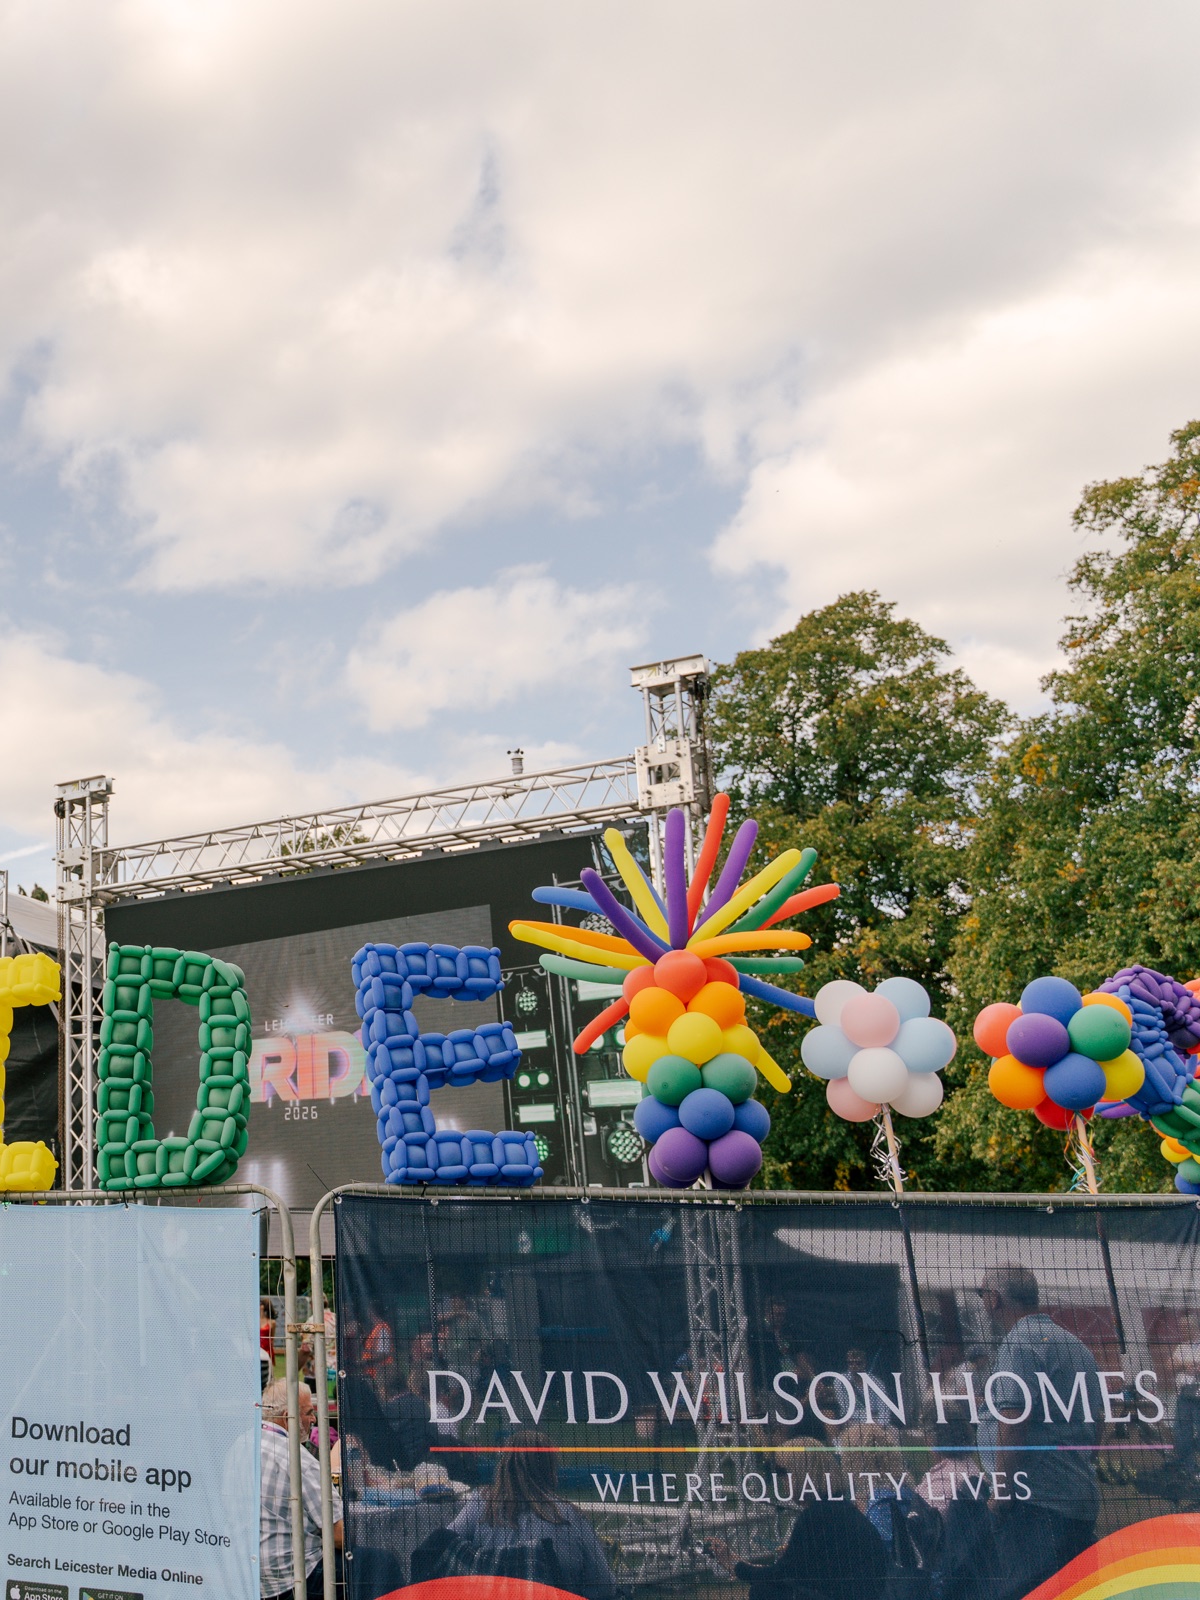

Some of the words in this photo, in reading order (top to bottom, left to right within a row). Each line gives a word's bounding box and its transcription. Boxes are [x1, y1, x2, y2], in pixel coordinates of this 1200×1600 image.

[265, 1013, 334, 1031] LEITER
[284, 1106, 318, 1120] 2026
[428, 1370, 629, 1424] DAVID
[647, 1370, 908, 1427] WILSON
[933, 1369, 1166, 1424] HOMES
[11, 1416, 131, 1446] Download
[9, 1457, 49, 1476] our
[56, 1458, 137, 1484] mobile
[145, 1466, 192, 1493] app
[590, 1472, 728, 1503] WHERE
[741, 1471, 909, 1505] QUALITY
[925, 1471, 1032, 1501] LIVES
[8, 1491, 72, 1510] Available
[75, 1495, 95, 1511] for
[99, 1498, 126, 1514] free
[130, 1500, 143, 1516] in
[147, 1503, 171, 1519] the
[8, 1512, 37, 1531] App
[41, 1515, 79, 1532] Store
[83, 1520, 98, 1534] or
[102, 1520, 154, 1541] Google
[159, 1525, 190, 1546] Play
[194, 1528, 231, 1548] Store
[7, 1553, 51, 1570] Search
[54, 1558, 114, 1576] Leicester
[117, 1564, 157, 1581] Media
[161, 1568, 204, 1586] Online
